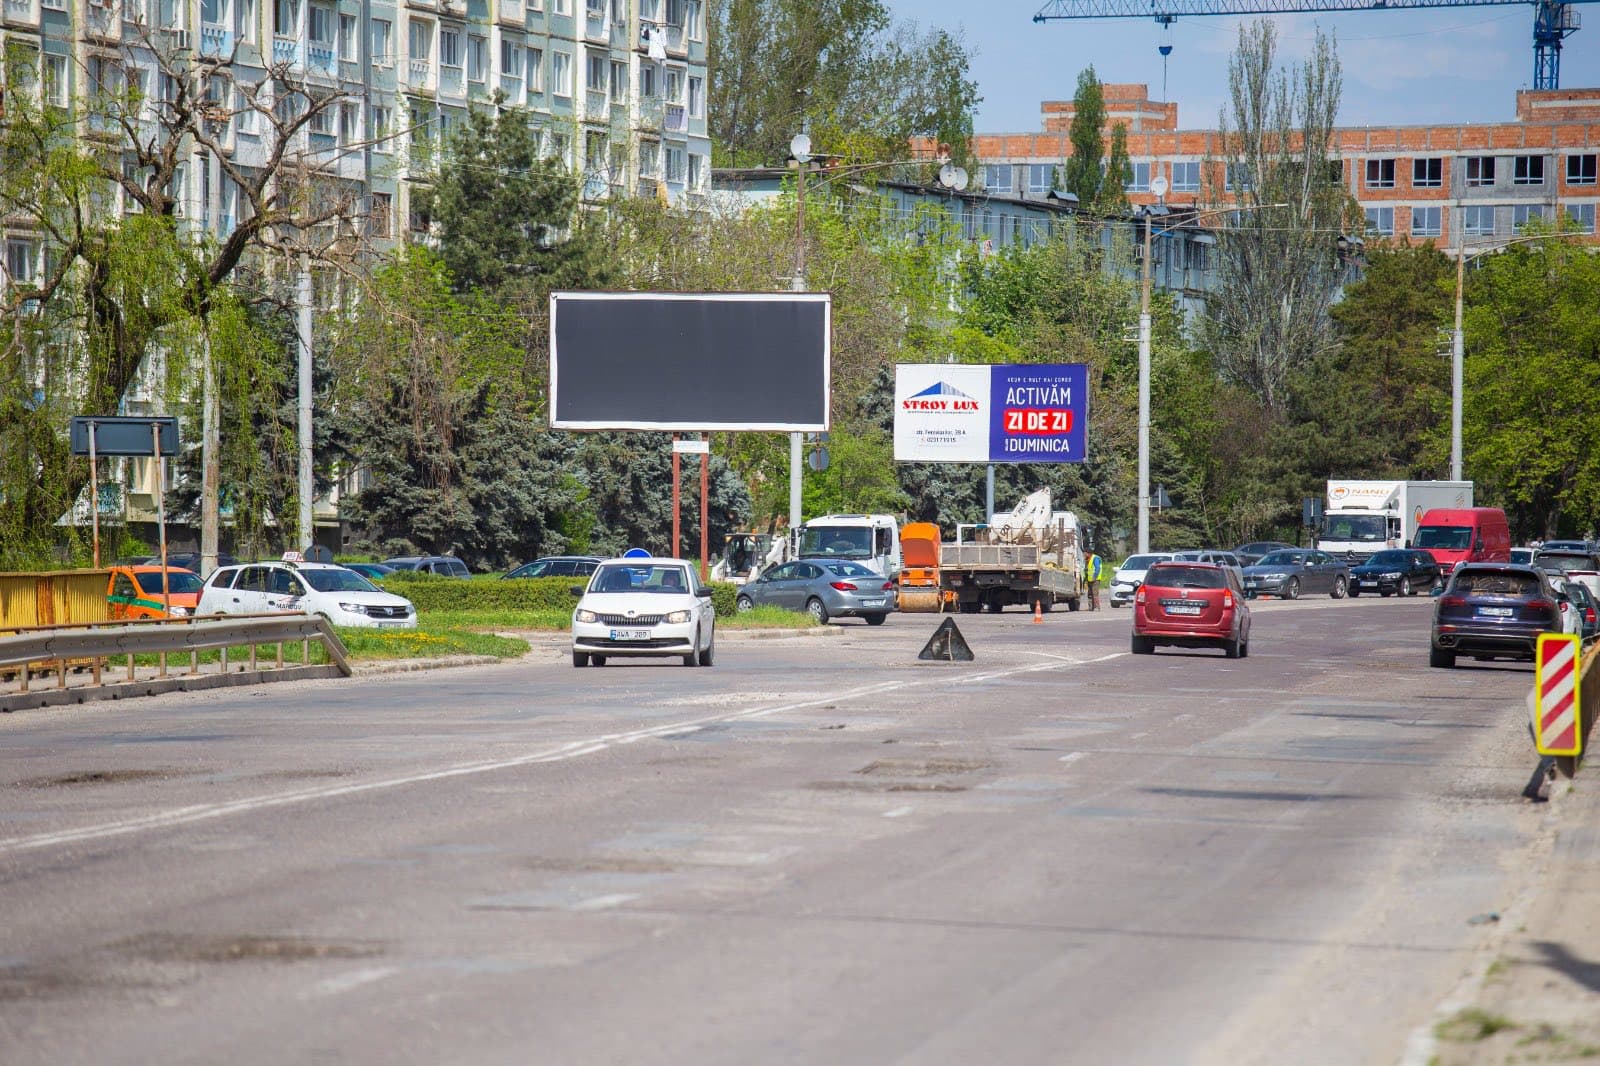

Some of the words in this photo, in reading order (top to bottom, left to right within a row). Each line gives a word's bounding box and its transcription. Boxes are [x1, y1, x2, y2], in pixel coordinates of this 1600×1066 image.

[1006, 384, 1071, 405] ACTIVĂM
[903, 400, 948, 410] STROY
[953, 400, 979, 411] LUX
[1008, 412, 1023, 430] ZI
[1027, 412, 1048, 430] DE
[1052, 412, 1067, 430] ZI
[1010, 438, 1070, 453] DUMINICA
